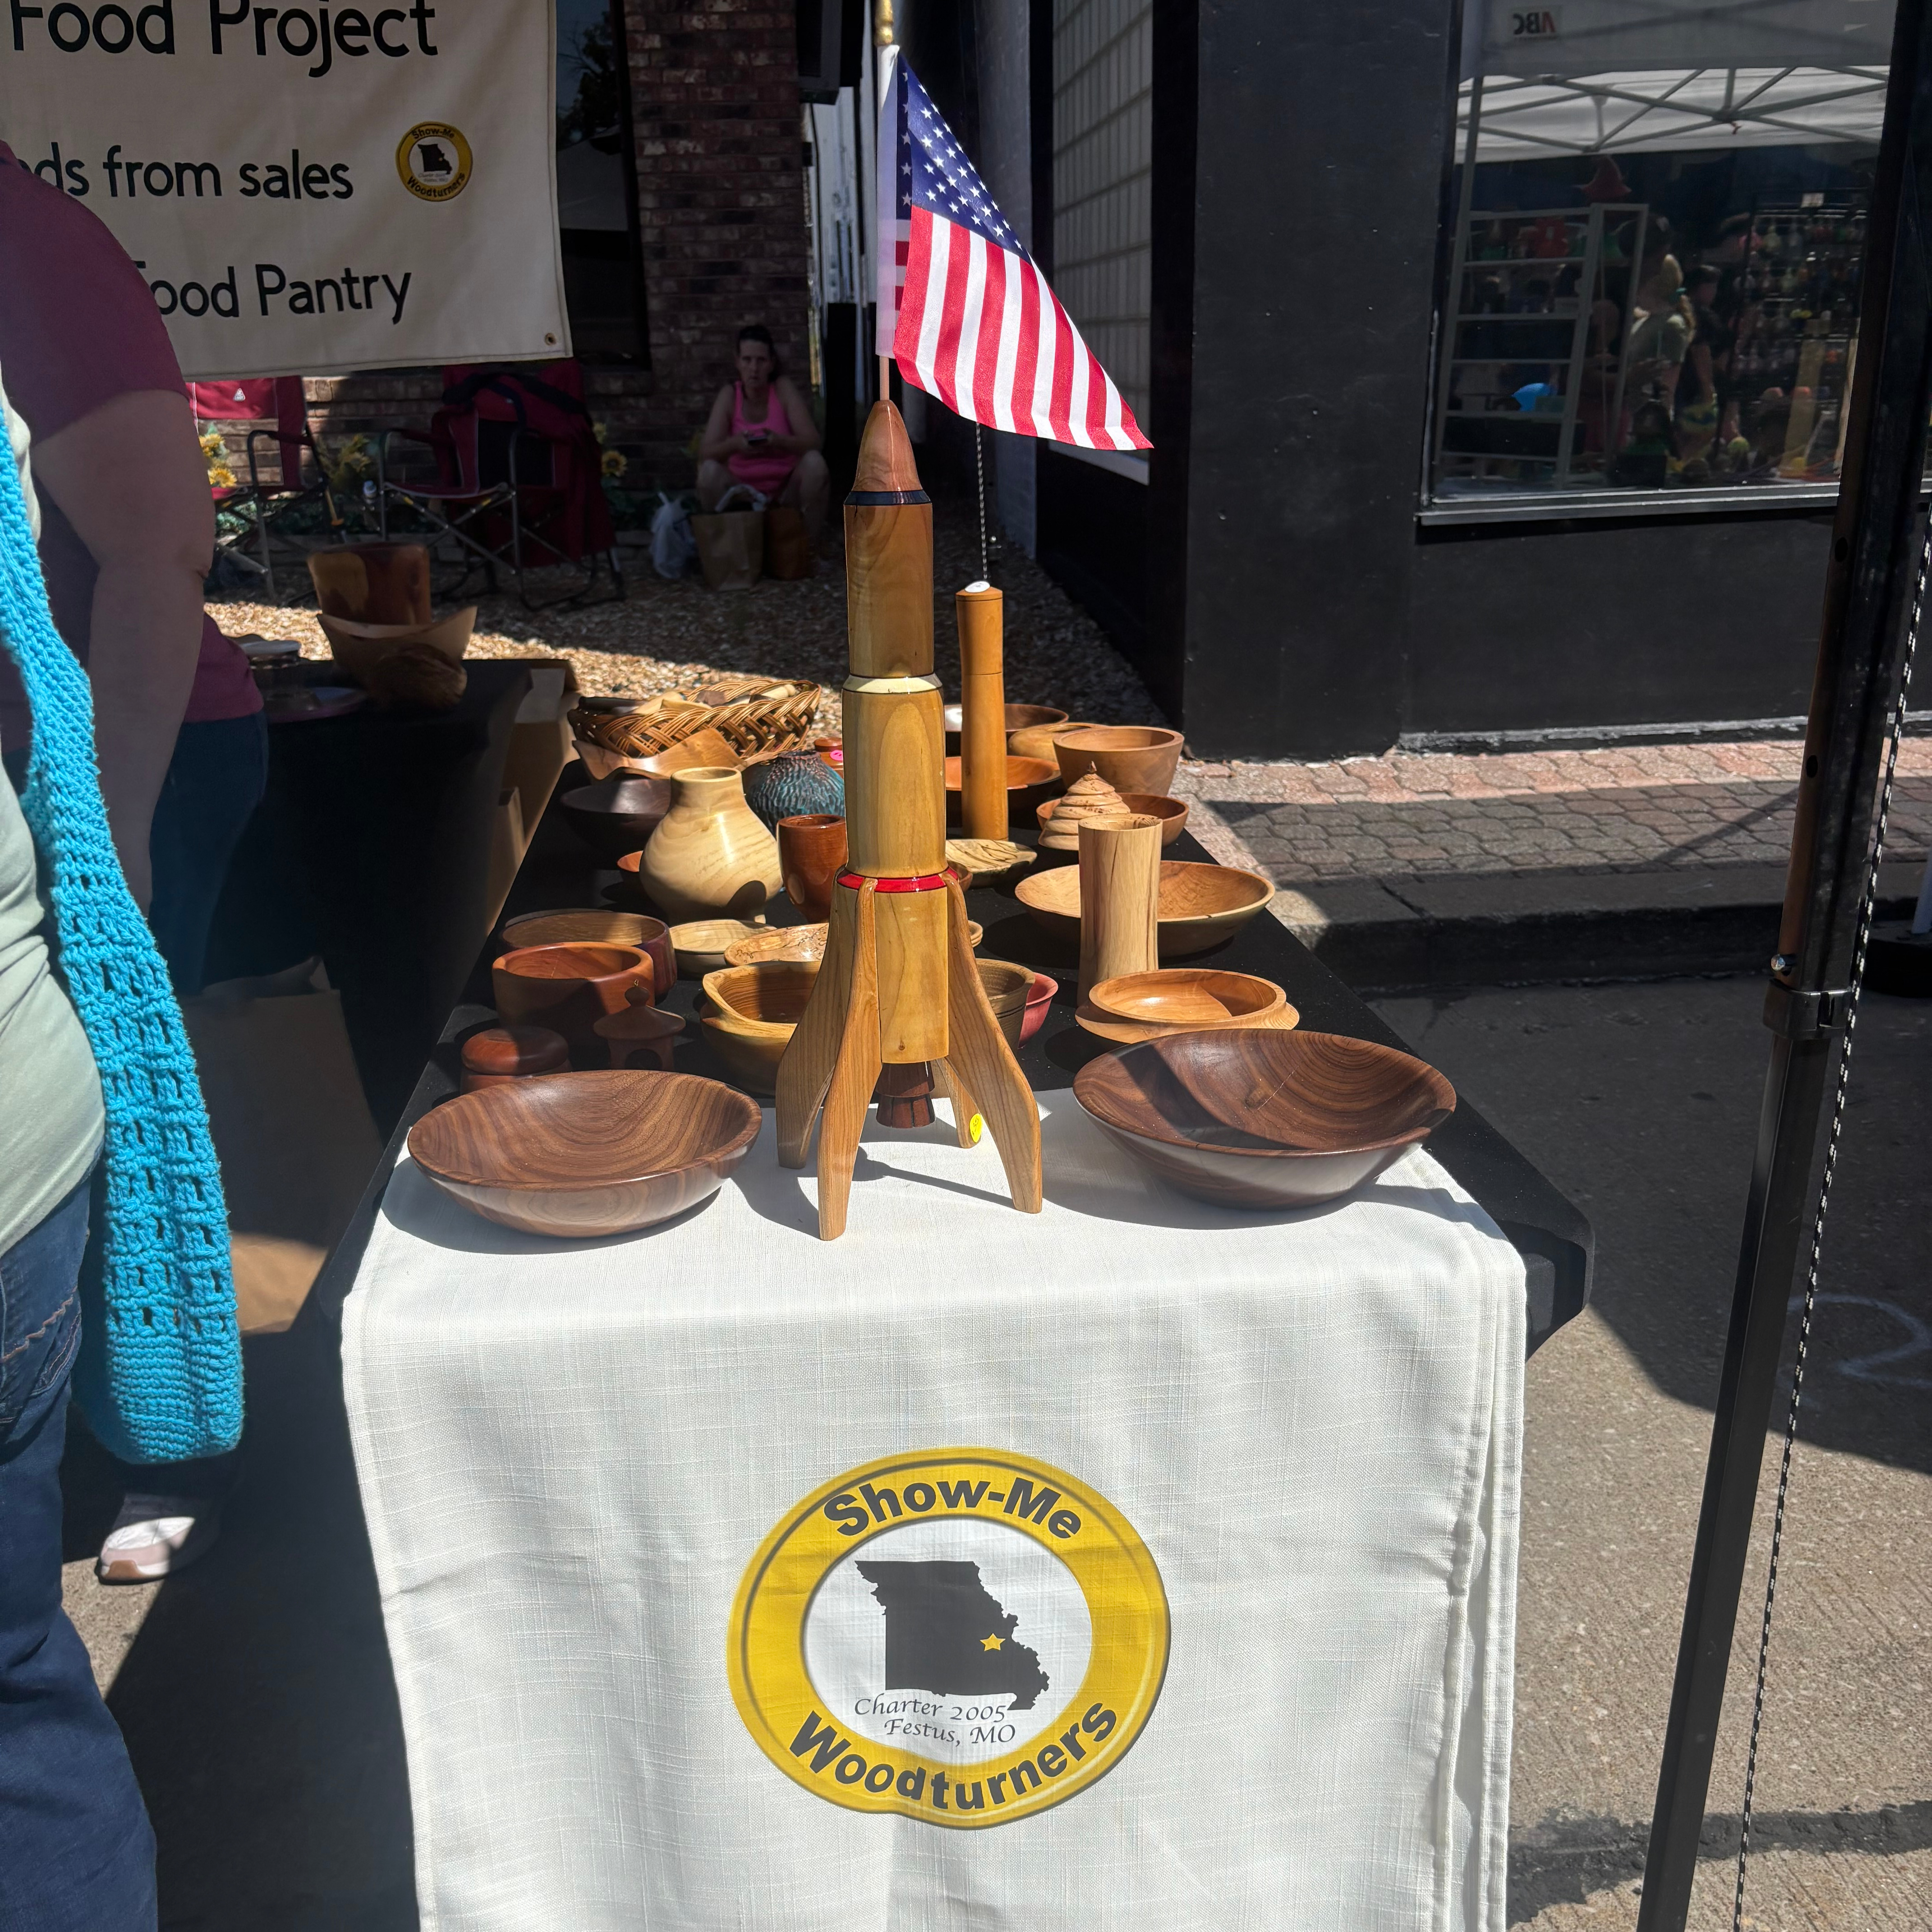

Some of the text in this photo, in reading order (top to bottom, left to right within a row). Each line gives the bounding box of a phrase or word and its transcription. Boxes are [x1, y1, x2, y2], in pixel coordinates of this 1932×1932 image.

[10, 0, 438, 78] Food Project
[412, 128, 455, 139] Show-Me
[17, 142, 354, 199] ds from sales
[407, 173, 465, 197] Woodturners
[133, 261, 412, 325] ood Pantry
[823, 1477, 1082, 1539] Show-Me
[854, 1693, 1007, 1723] Charter 2005
[884, 1718, 1016, 1747] Festus, MO
[788, 1702, 1117, 1810] Woodturners
